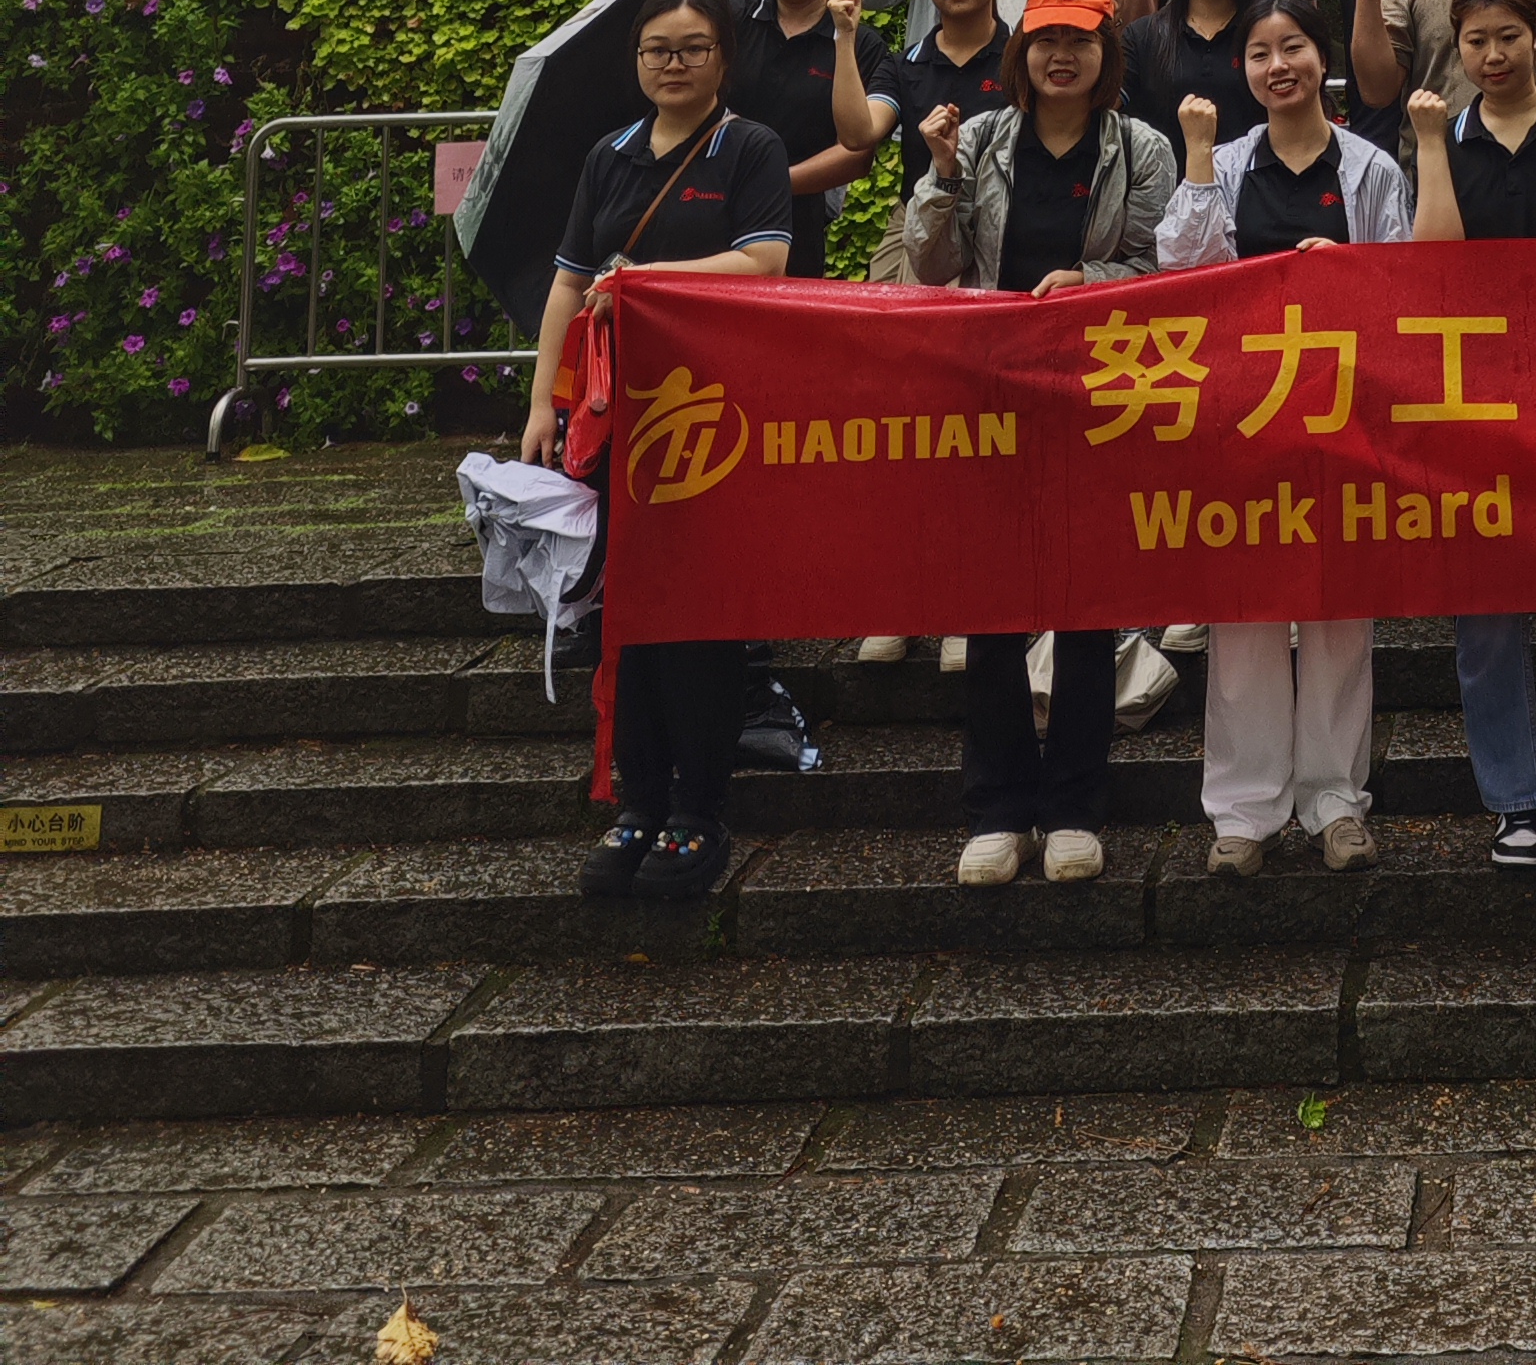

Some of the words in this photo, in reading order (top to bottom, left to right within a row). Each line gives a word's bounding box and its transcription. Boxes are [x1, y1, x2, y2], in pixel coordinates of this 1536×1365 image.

[764, 412, 1017, 465] HAOTIAN
[1130, 481, 1317, 550] Work
[1342, 474, 1513, 541] Hard
[8, 812, 86, 833] 小心台阶
[31, 837, 57, 847] YOUR
[61, 836, 85, 846] STEP
